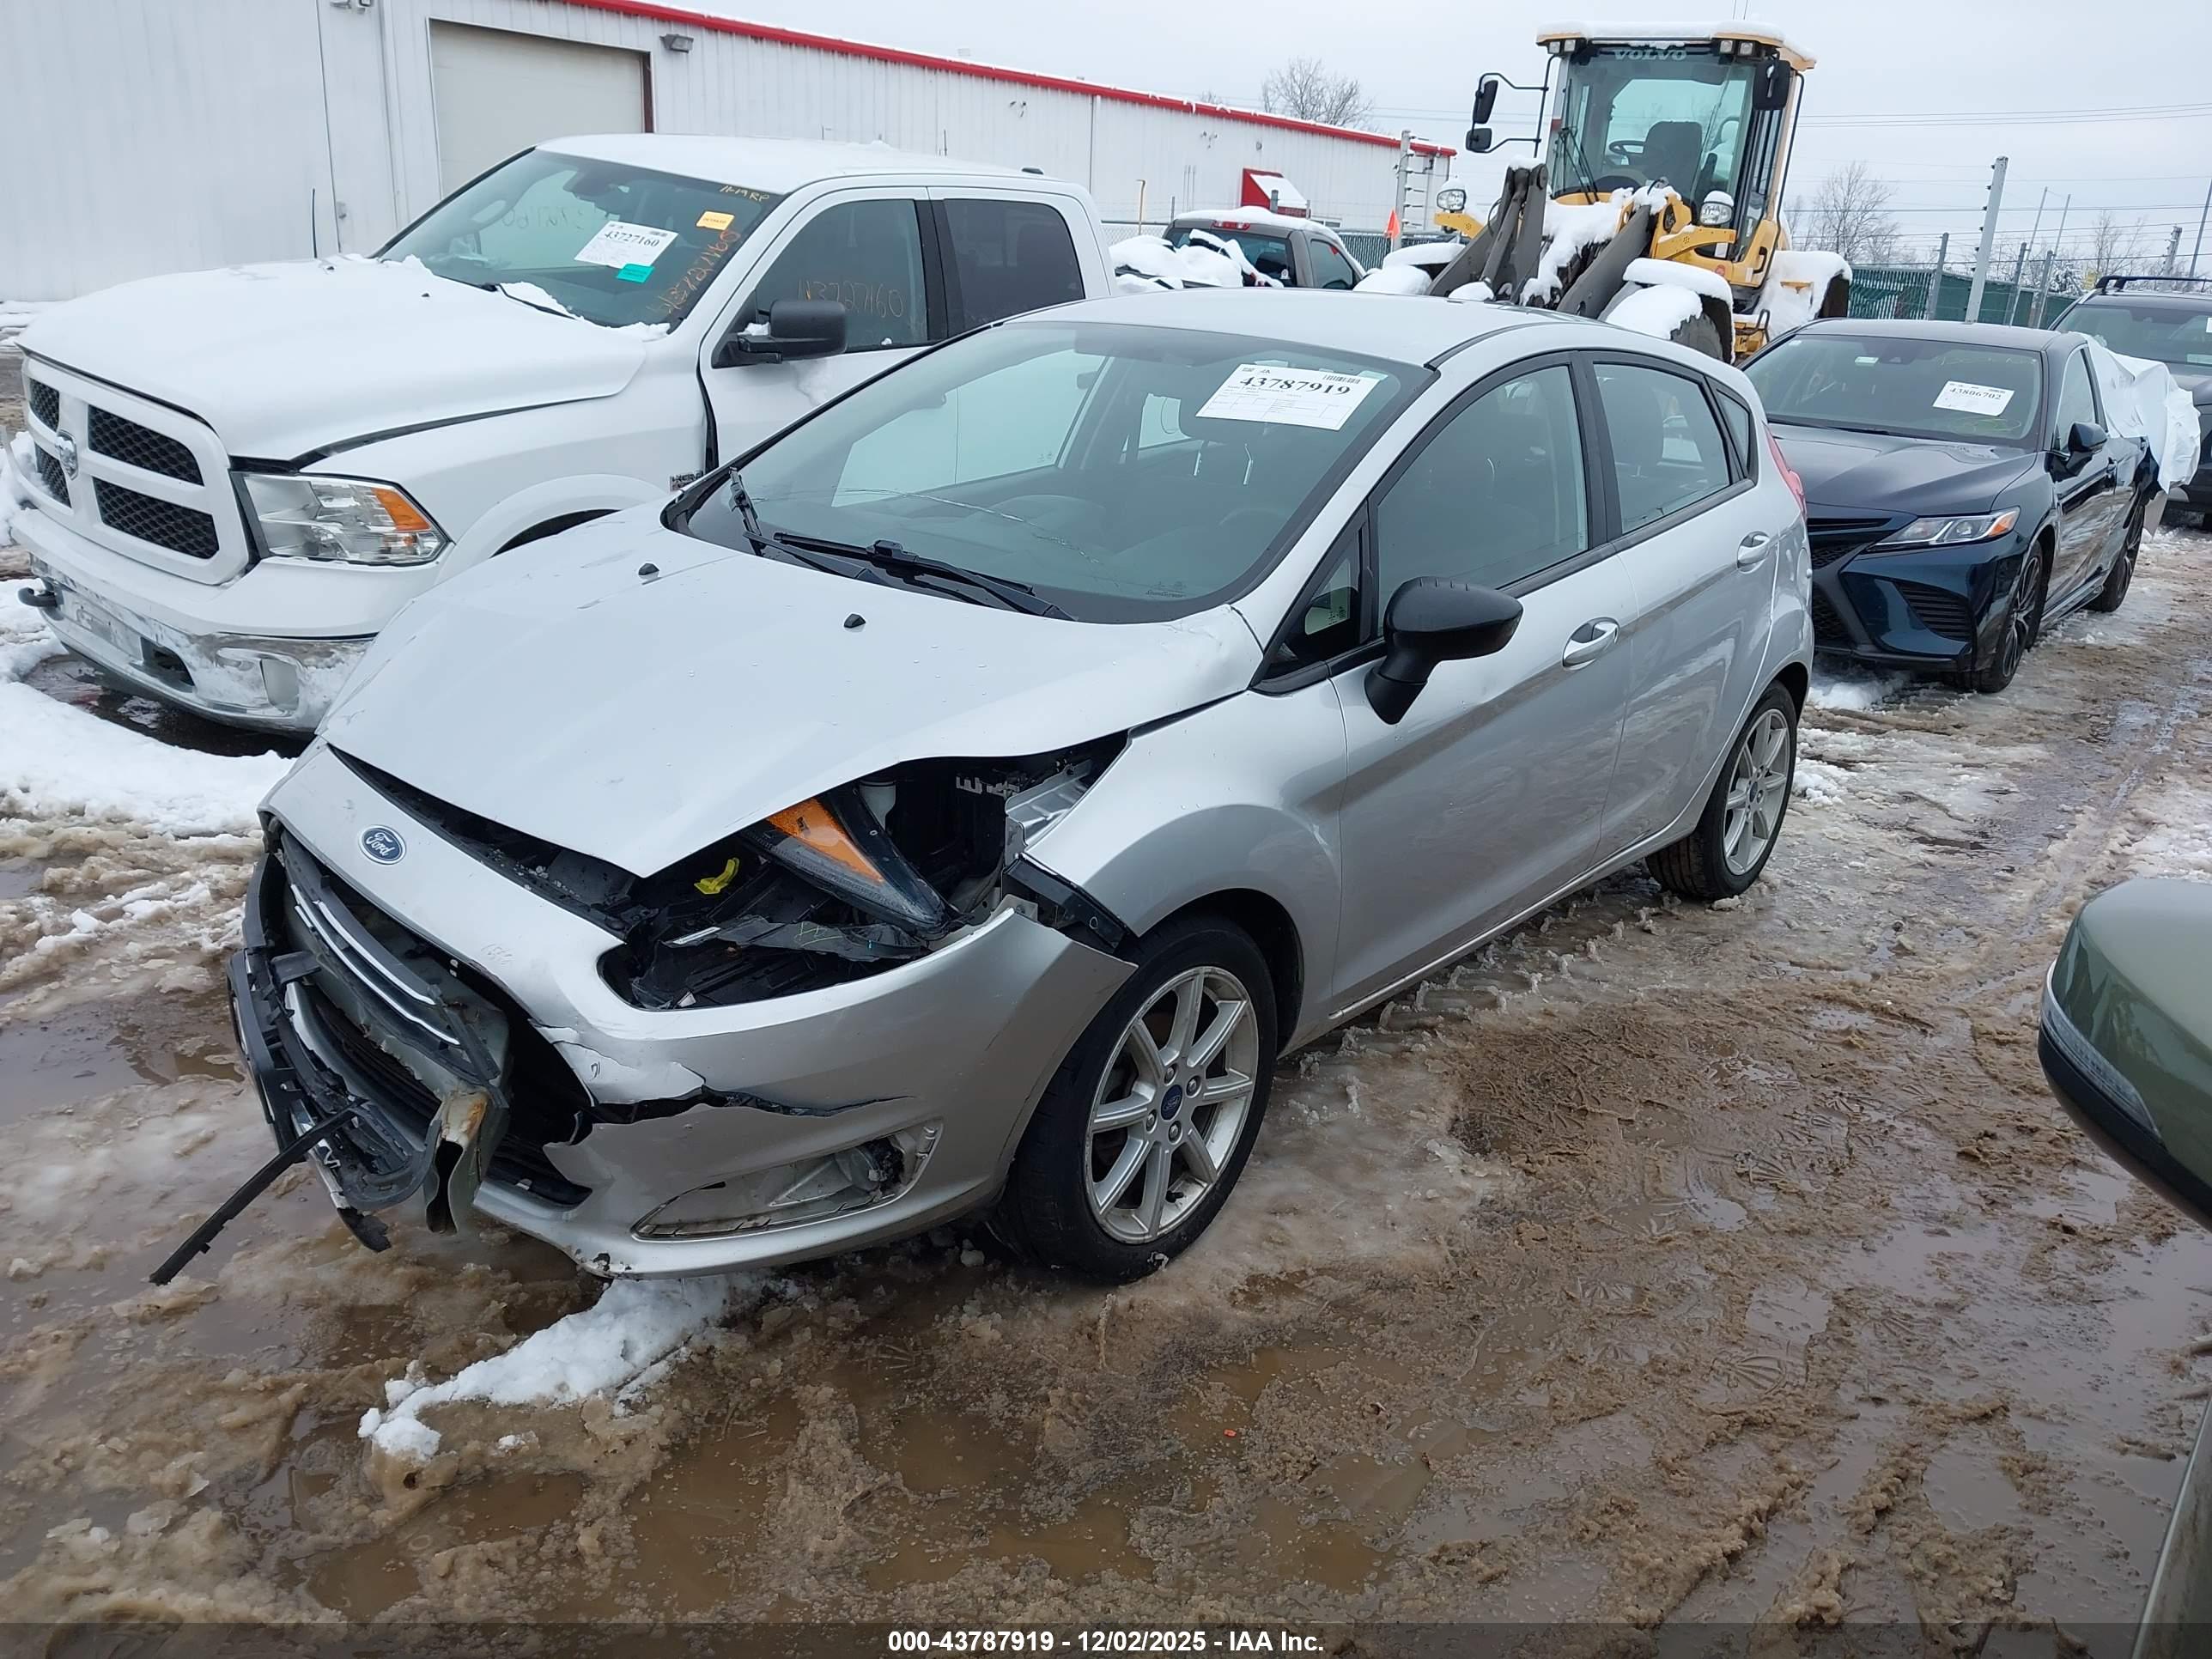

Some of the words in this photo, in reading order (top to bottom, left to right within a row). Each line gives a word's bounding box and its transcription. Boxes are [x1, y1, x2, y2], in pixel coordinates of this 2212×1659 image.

[1613, 49, 1686, 61] VOLVO
[605, 230, 660, 247] 43727160
[1240, 376, 1351, 395] 43787919
[1949, 387, 2002, 400] 43806702
[366, 832, 396, 856] Ford
